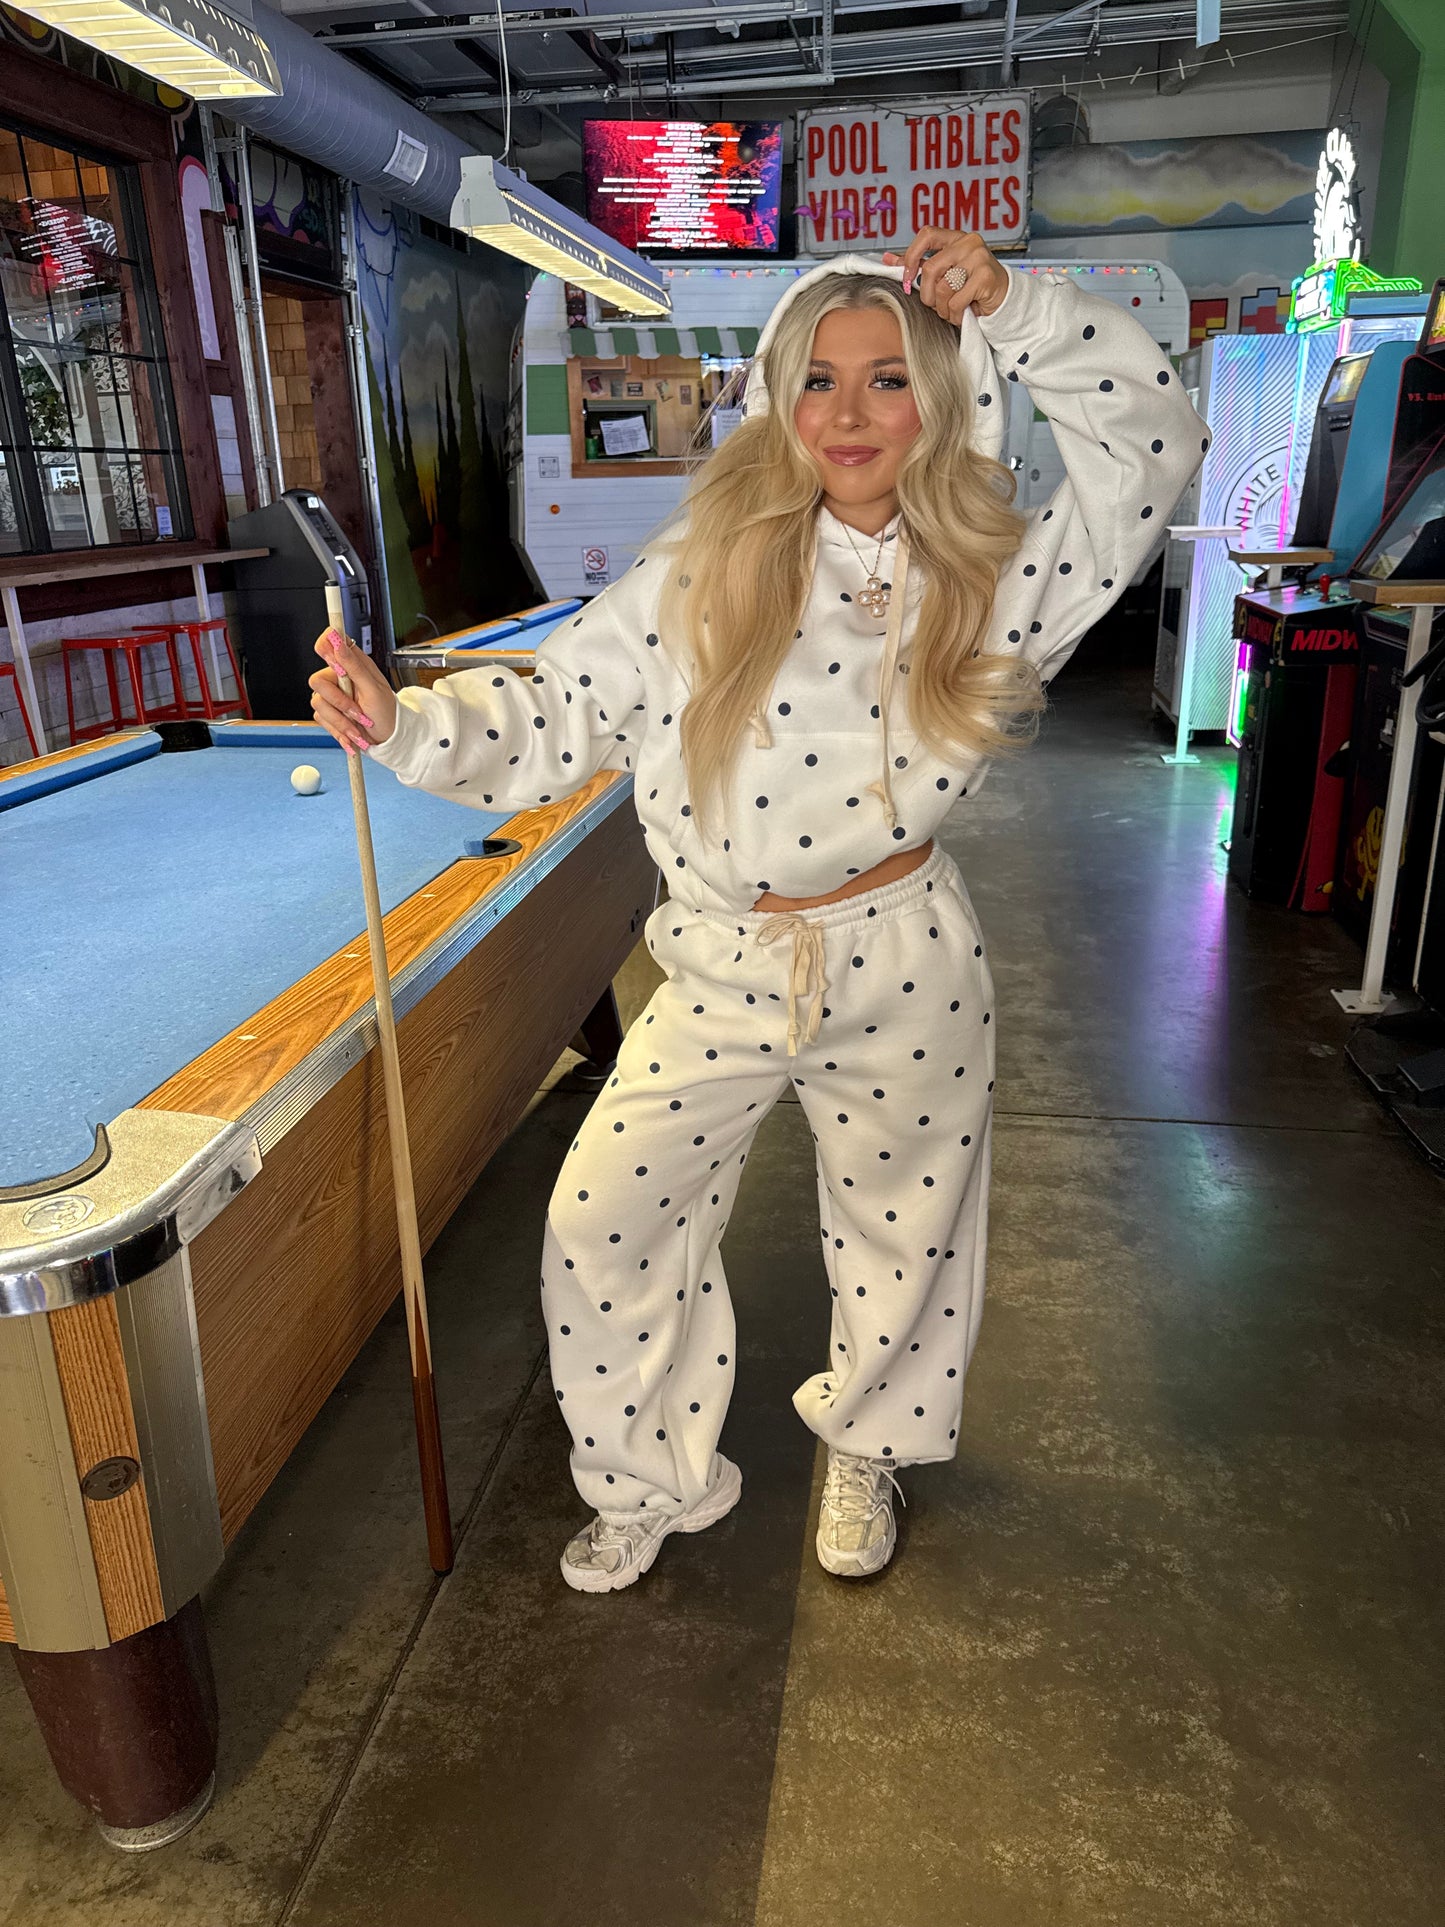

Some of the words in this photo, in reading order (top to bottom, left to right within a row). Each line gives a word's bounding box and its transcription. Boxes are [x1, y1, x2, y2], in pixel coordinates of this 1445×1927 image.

[807, 122, 888, 178] POOL
[904, 109, 1021, 171] TABLES
[654, 230, 710, 239] COCKTAILS
[808, 184, 897, 242] VIDEO
[912, 176, 1021, 235] GAMES
